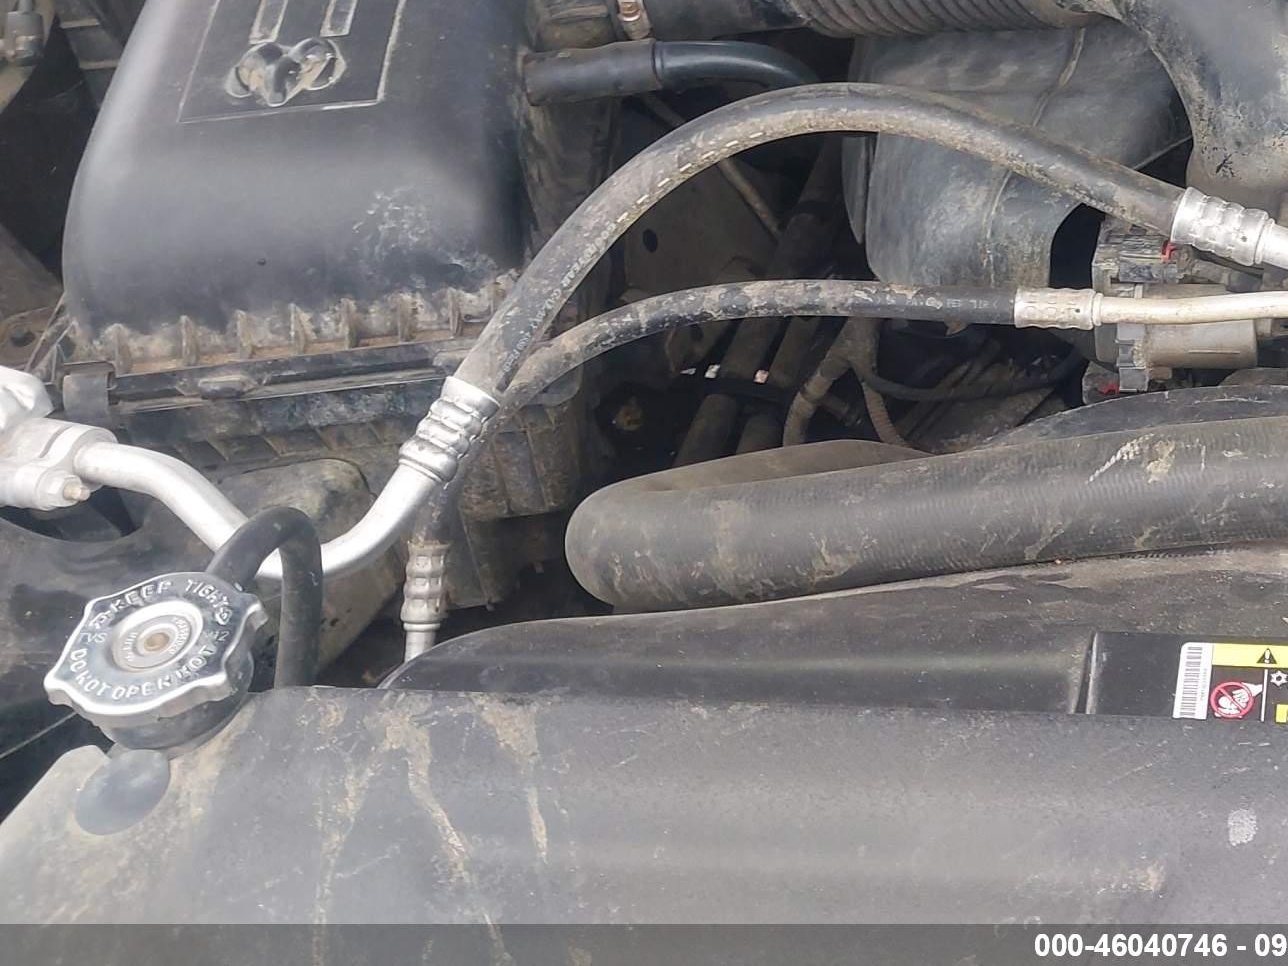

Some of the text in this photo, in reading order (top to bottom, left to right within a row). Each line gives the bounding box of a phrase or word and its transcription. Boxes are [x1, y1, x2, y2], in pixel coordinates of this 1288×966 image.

[112, 578, 231, 610] KEEP TIGHT
[78, 632, 108, 644] TVS
